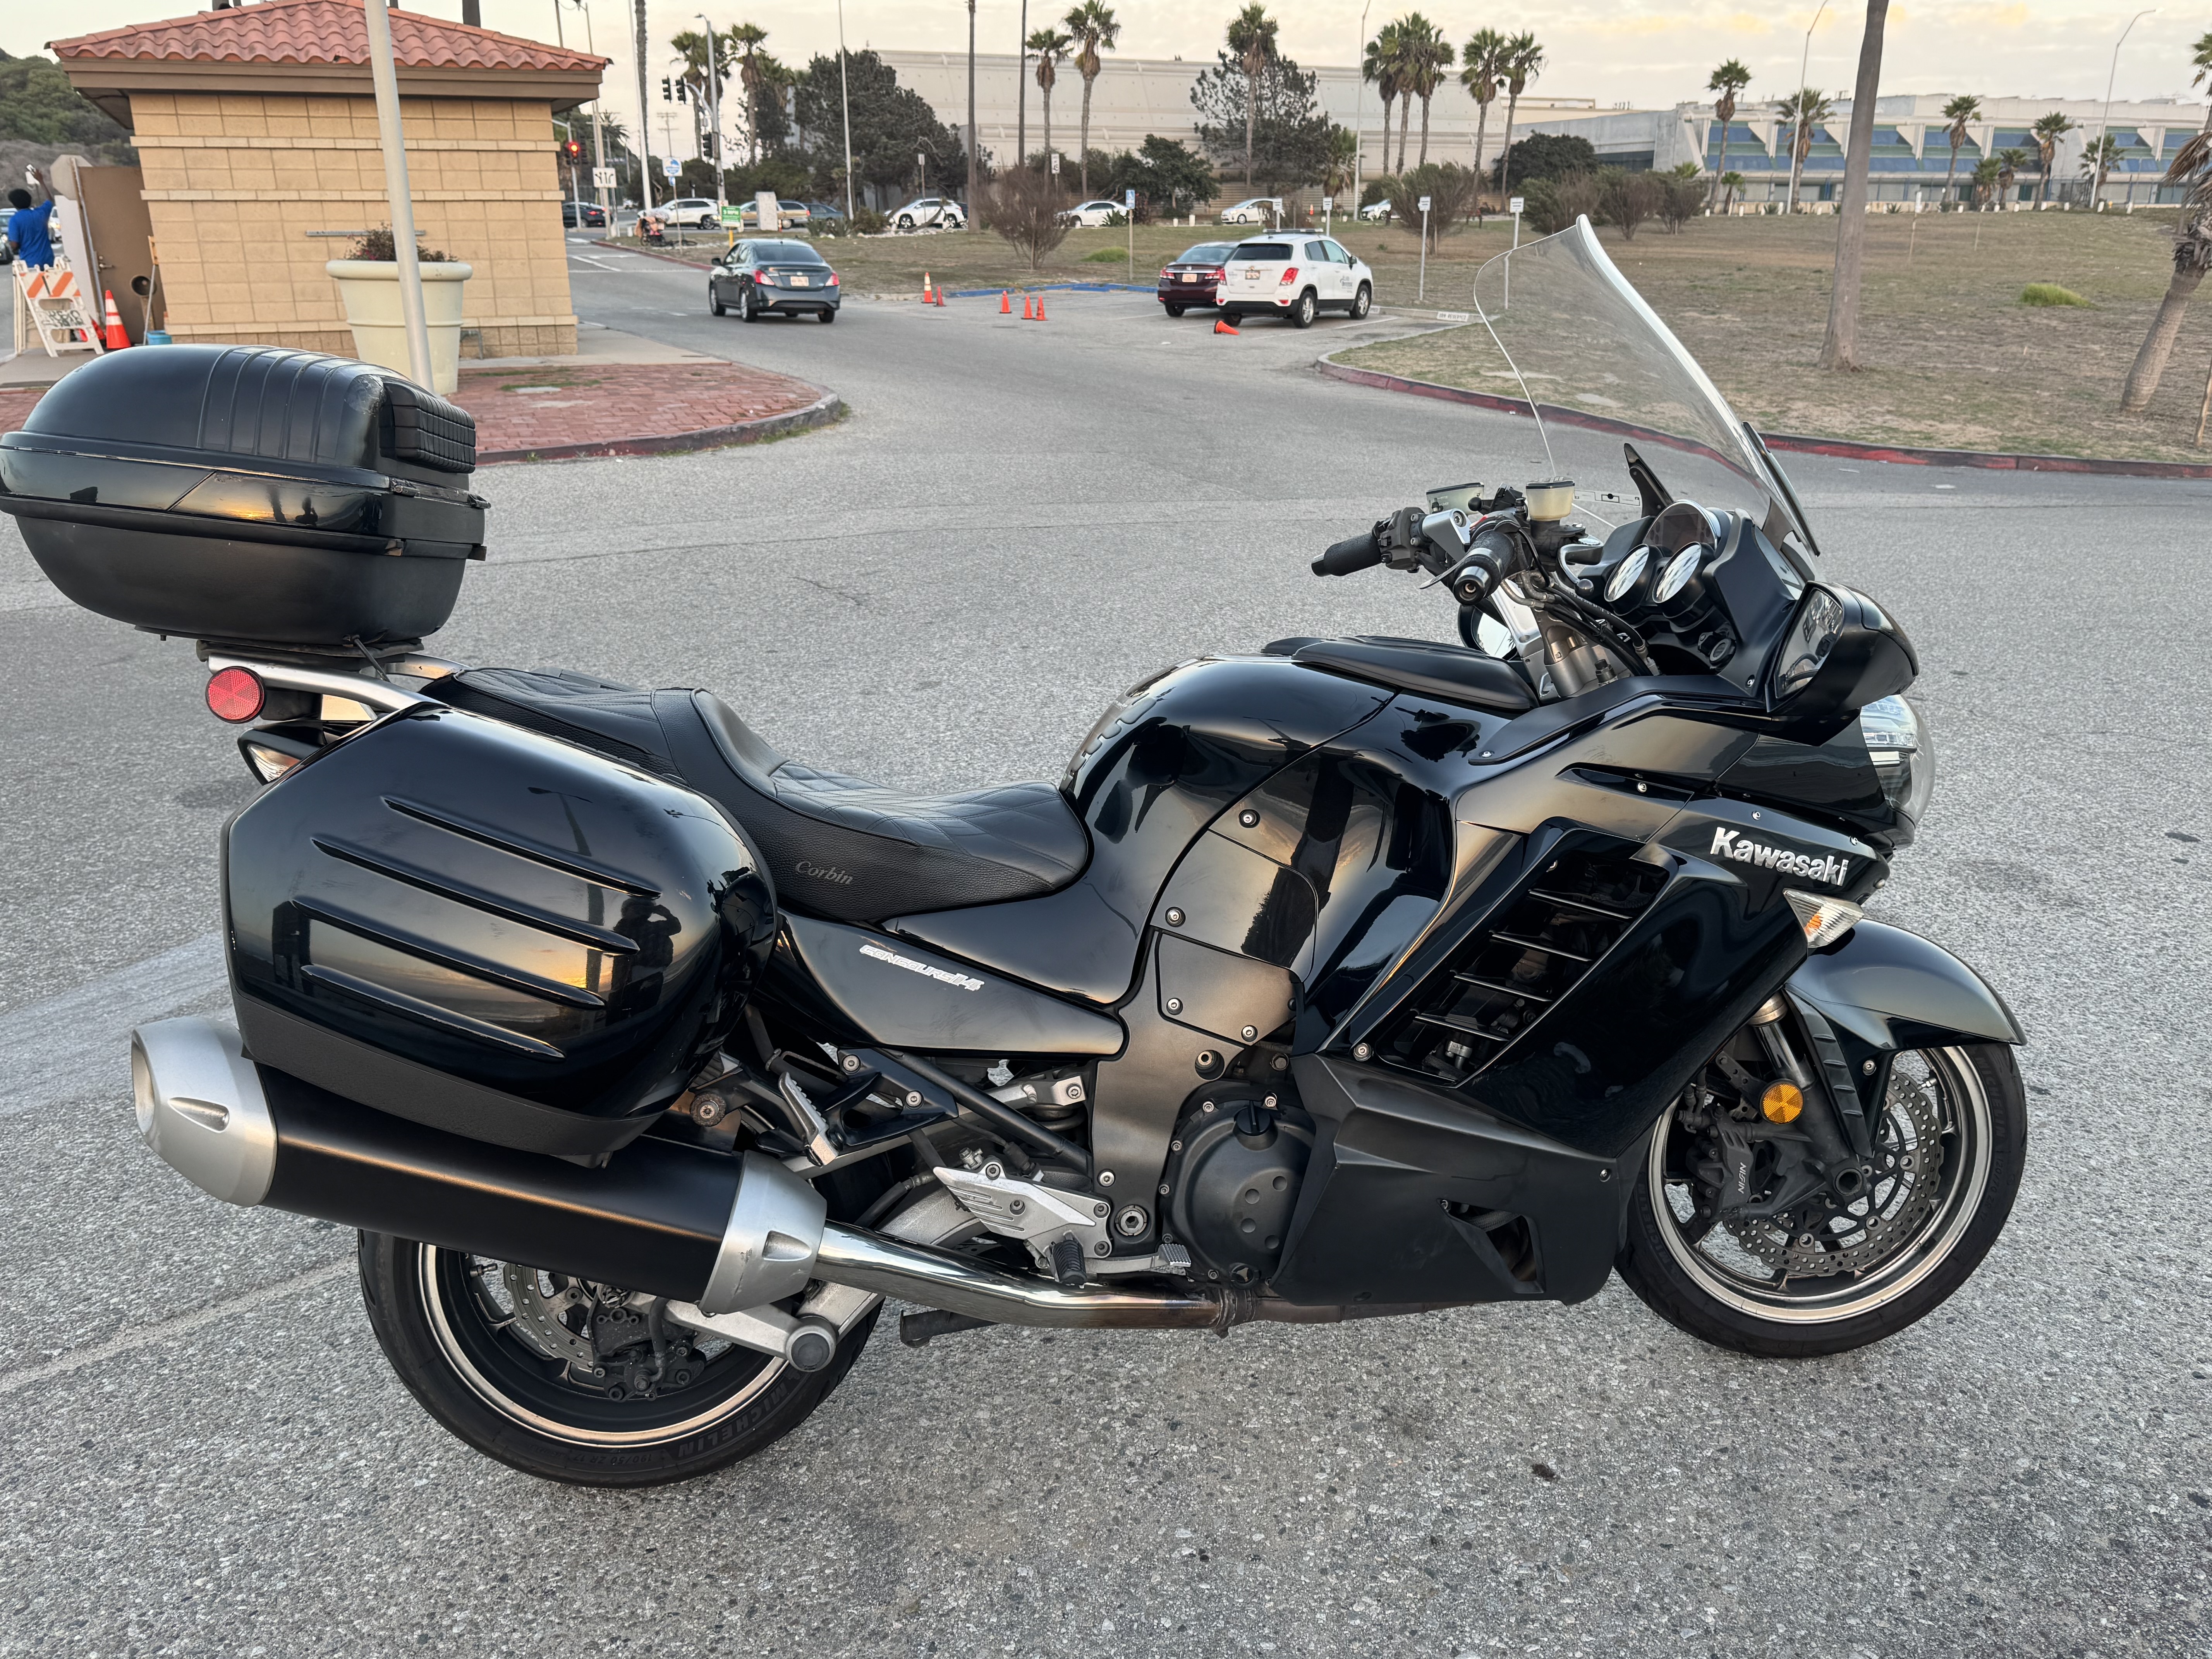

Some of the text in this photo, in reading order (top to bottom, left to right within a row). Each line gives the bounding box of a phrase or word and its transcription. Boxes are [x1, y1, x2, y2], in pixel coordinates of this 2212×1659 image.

[795, 861, 853, 884] Corbin
[1710, 827, 1849, 886] Kawasaki
[1975, 1057, 2006, 1139] MICHELIN
[1738, 1162, 1747, 1194] NISSIN
[1638, 1183, 1671, 1264] MICHELIN
[678, 1382, 787, 1458] MICHELIN
[590, 1456, 605, 1464] ZR
[611, 1453, 652, 1465] 190/50
